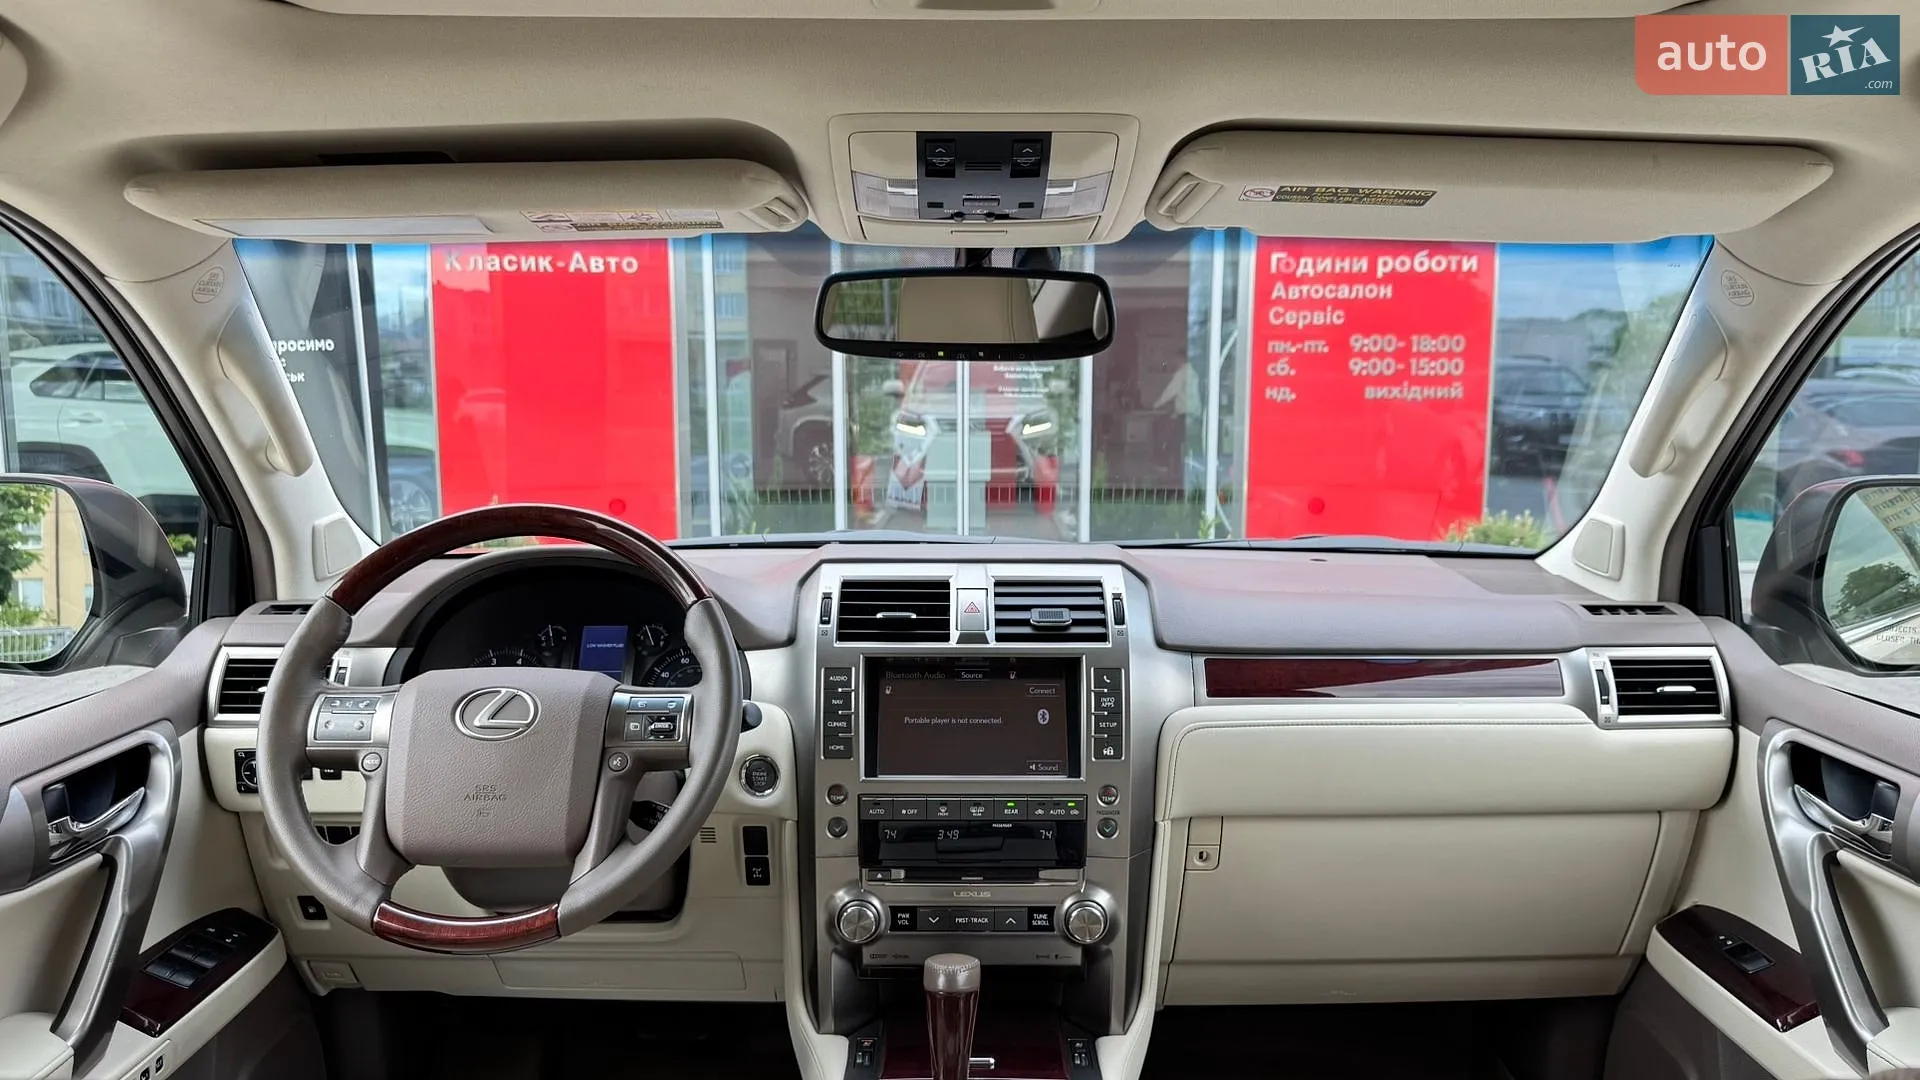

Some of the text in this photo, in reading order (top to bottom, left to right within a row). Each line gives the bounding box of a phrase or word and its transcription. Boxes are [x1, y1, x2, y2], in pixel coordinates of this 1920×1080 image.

[1358, 188, 1433, 197] WARNING
[445, 250, 638, 274] Класик-Авто
[1269, 249, 1479, 278] Години роботи
[1271, 282, 1393, 300] Автосалон
[1268, 306, 1345, 329] Сервіс
[1411, 334, 1466, 353] 18:00
[1266, 358, 1296, 376] сб.
[1410, 357, 1465, 376] 15:00
[1265, 382, 1464, 403] нд. вихідний
[491, 657, 522, 666] 3 4
[885, 671, 946, 679] Bluetooth Audio
[961, 671, 984, 679] Source
[1029, 686, 1056, 695] Connect
[904, 716, 930, 724] Portable
[931, 716, 950, 725] player
[951, 716, 957, 724] is
[957, 716, 968, 724] not
[1038, 763, 1059, 771] Sound
[475, 784, 497, 792] SRS
[464, 793, 508, 802] AIRBAG
[884, 829, 897, 840] 74
[1039, 829, 1053, 840] 74
